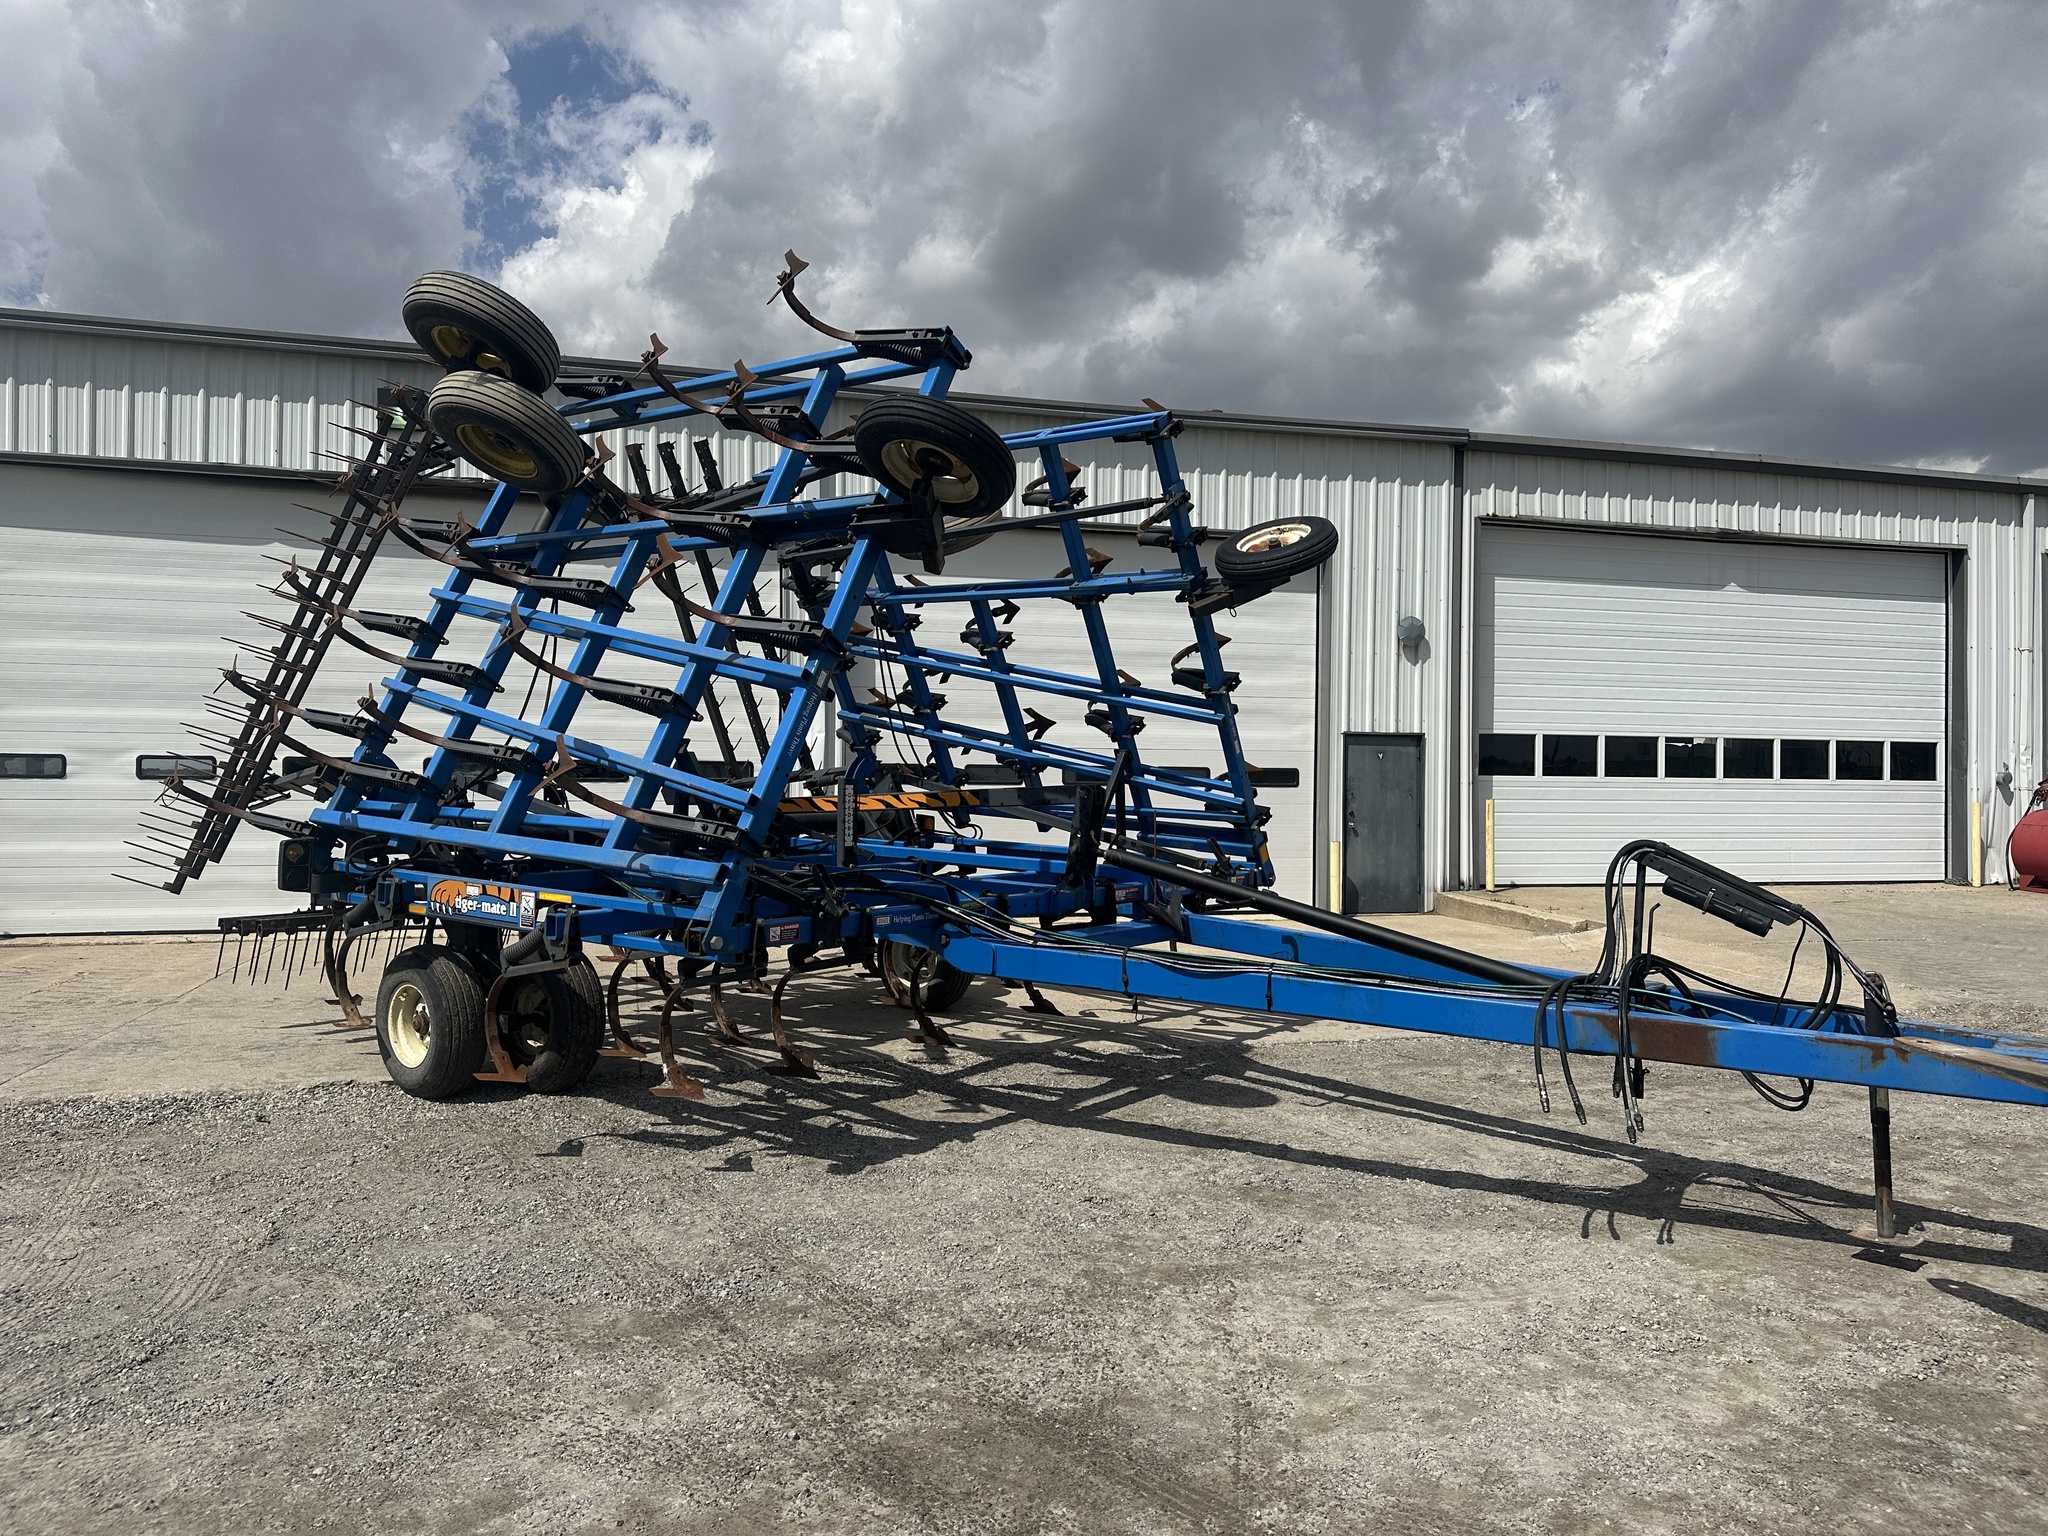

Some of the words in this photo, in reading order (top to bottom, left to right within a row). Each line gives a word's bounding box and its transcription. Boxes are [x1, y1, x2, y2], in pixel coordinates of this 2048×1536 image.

[803, 692, 818, 717] Helping
[454, 895, 507, 916] tiger-mate
[509, 902, 517, 917] II
[893, 915, 911, 924] Helping
[911, 913, 925, 921] Plants
[925, 912, 939, 920] Thrive
